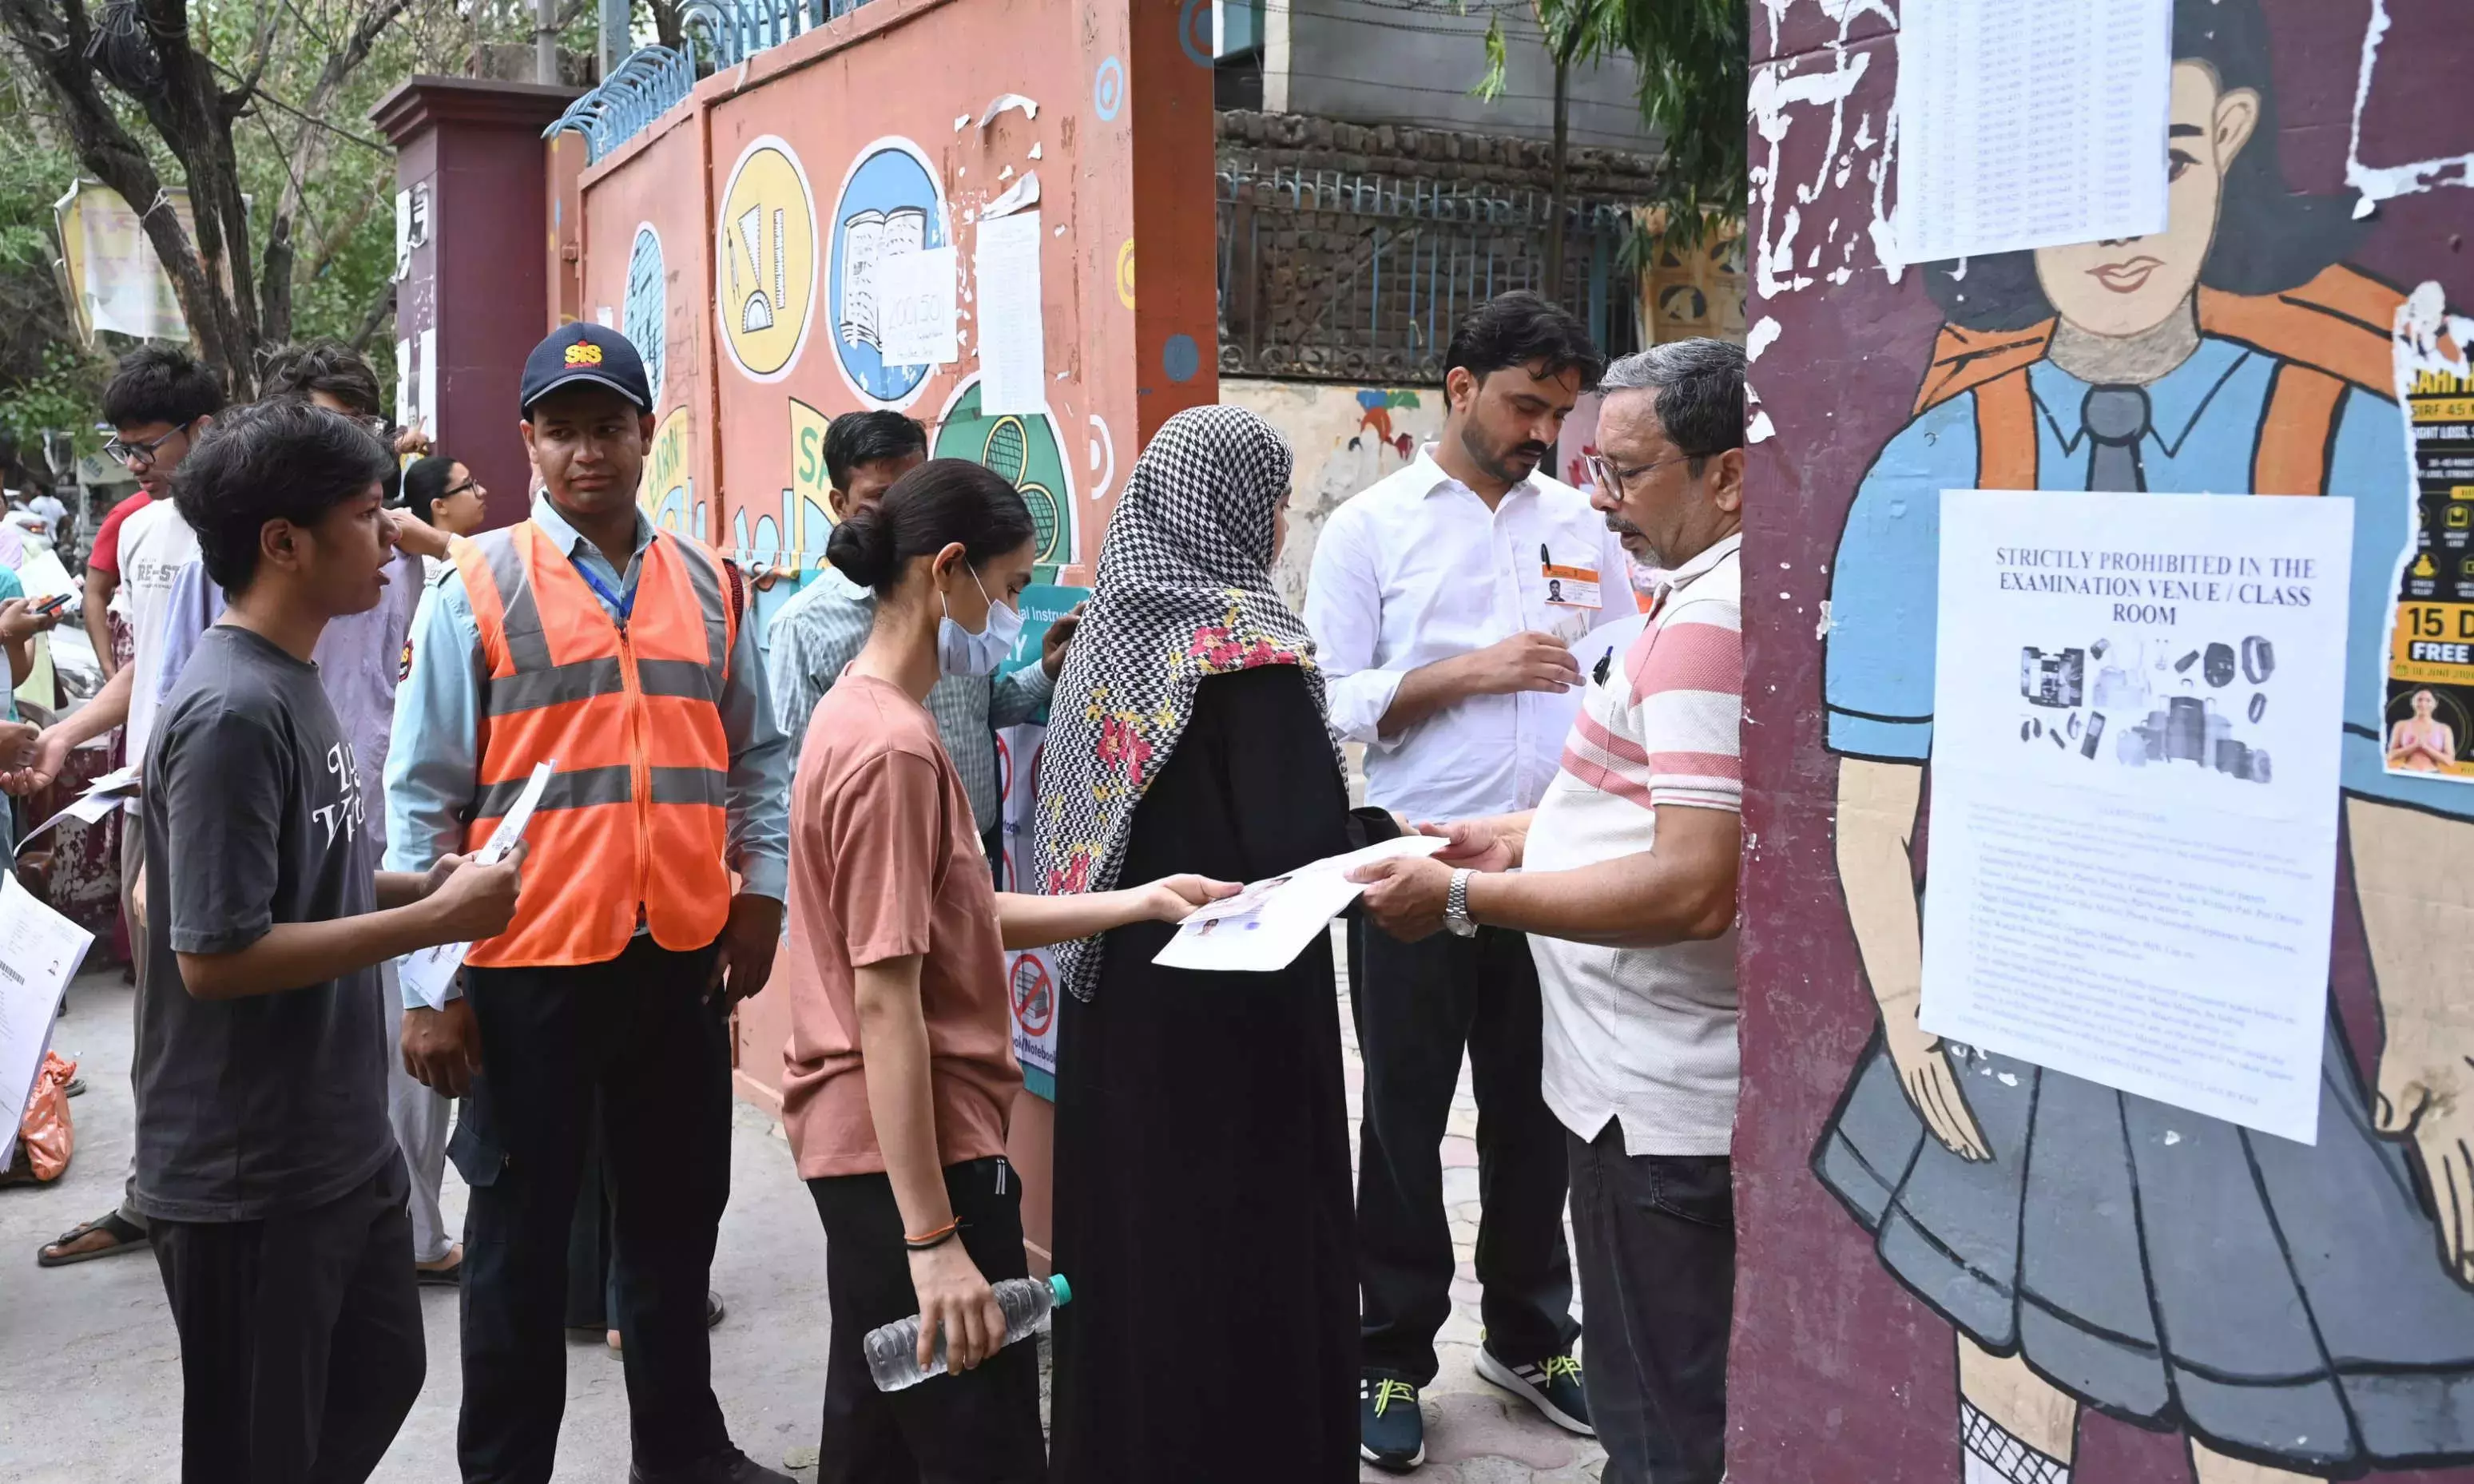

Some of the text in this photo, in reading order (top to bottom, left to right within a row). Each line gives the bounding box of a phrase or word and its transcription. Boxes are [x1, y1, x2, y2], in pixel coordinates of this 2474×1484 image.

[564, 339, 602, 363] SIS
[2447, 403, 2464, 415] 45
[1996, 547, 2317, 579] STRICTLY PROHIBITED IN THE
[1999, 572, 2141, 597] EXAMINATION
[2148, 580, 2221, 601] VENUE
[2238, 584, 2312, 607] CLASS
[2113, 603, 2177, 625] ROOM
[2408, 608, 2444, 637] 15
[2412, 641, 2470, 663] FREE
